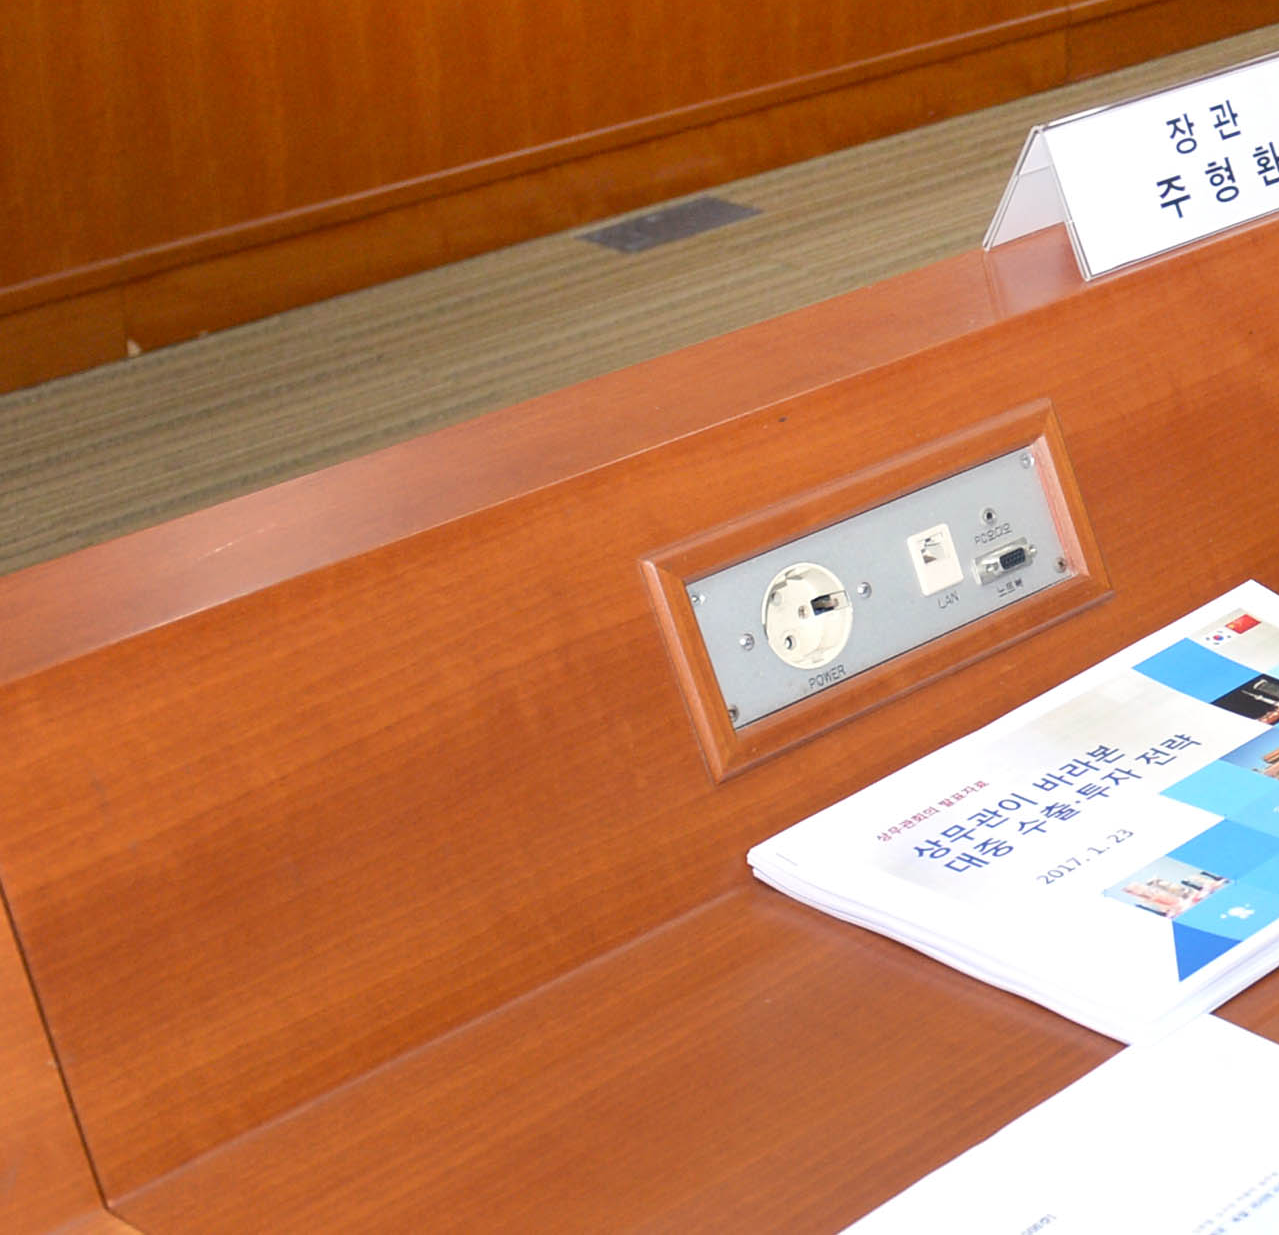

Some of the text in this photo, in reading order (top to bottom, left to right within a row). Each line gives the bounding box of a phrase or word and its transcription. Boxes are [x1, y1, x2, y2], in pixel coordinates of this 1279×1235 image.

[937, 591, 960, 610] LAN
[808, 664, 847, 690] POWER
[876, 780, 990, 842] 상무관회의 발표자료
[913, 744, 1126, 860] 상무관이 바라본
[944, 838, 1014, 873] 대중
[1134, 733, 1203, 766] 전략
[1036, 857, 1091, 885] 2017.
[1107, 828, 1135, 844] 23
